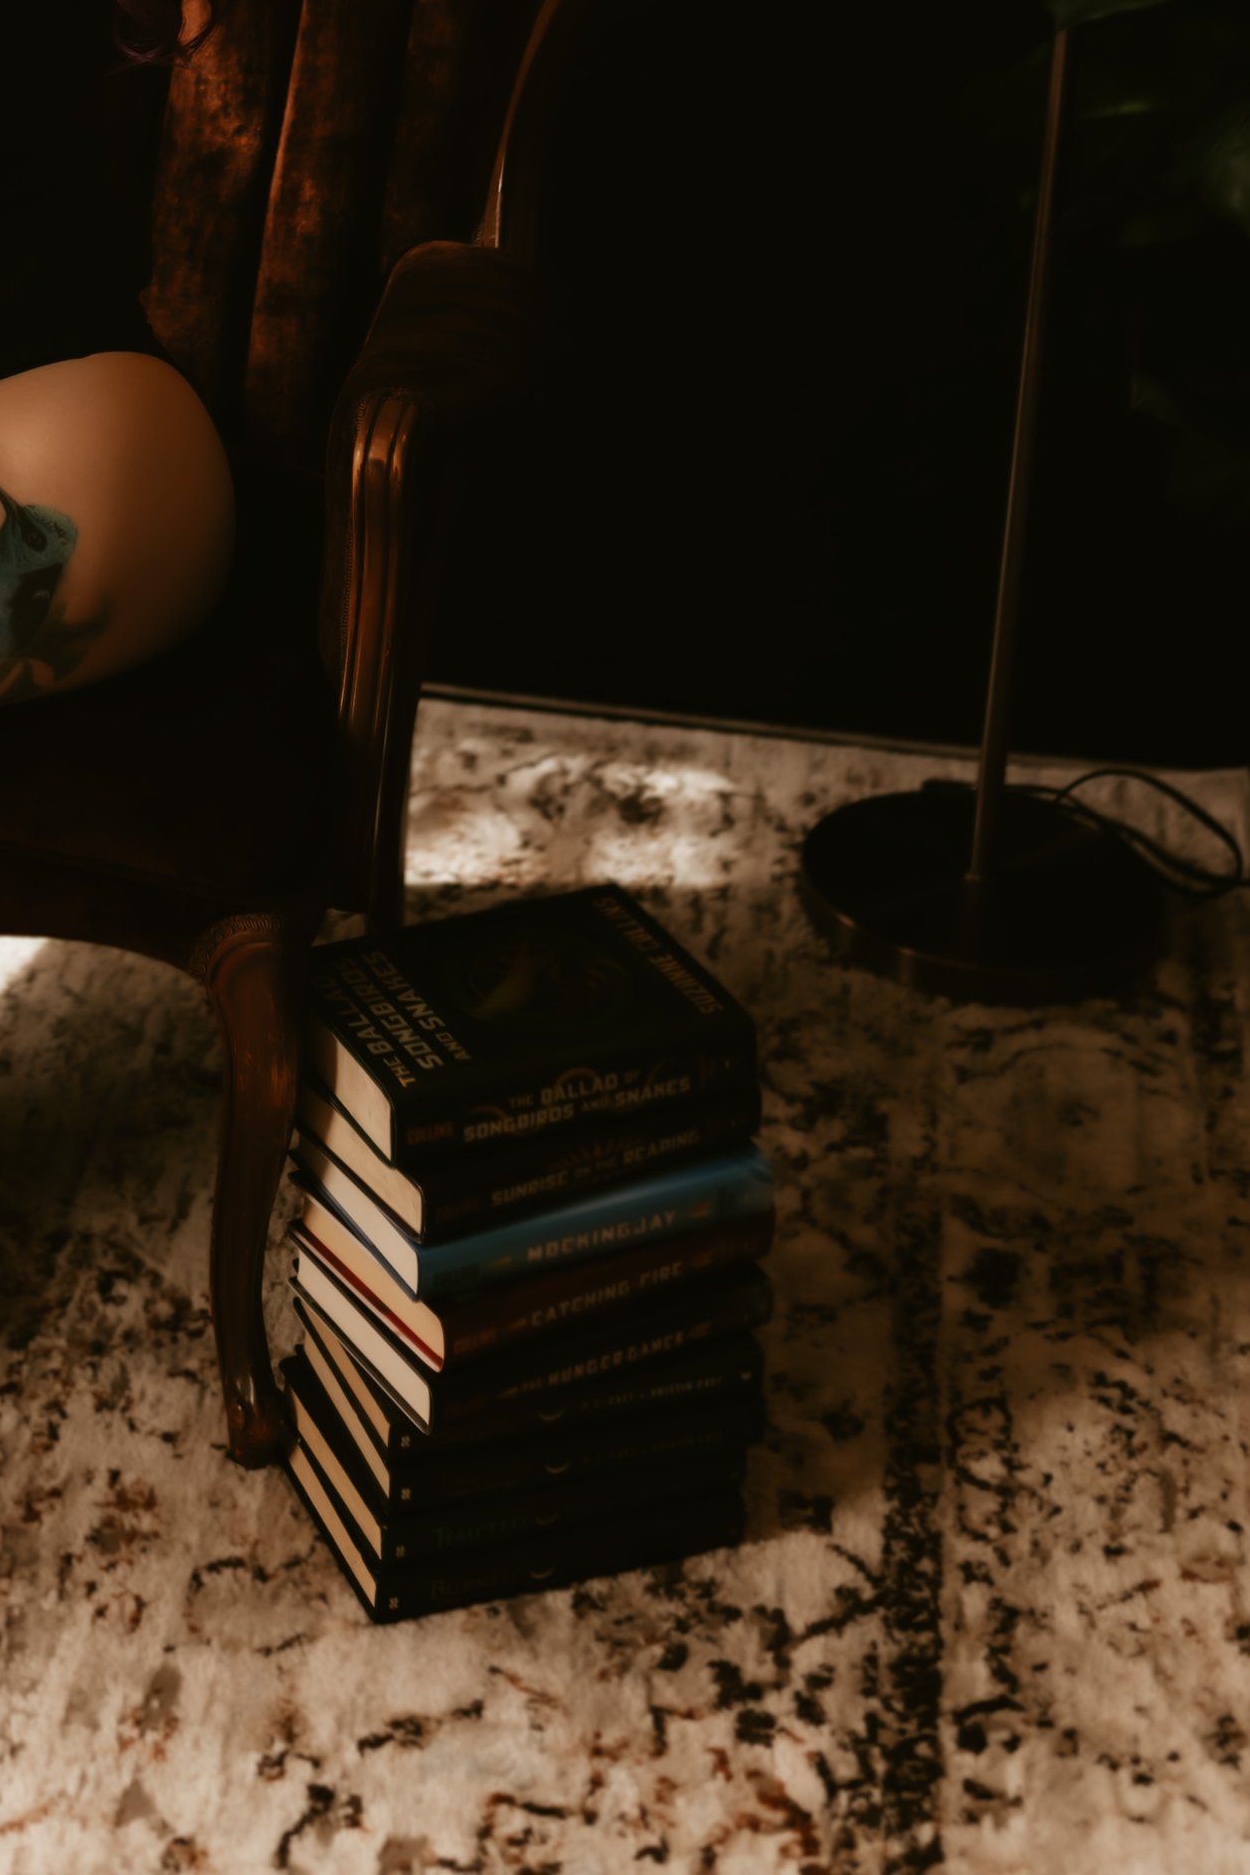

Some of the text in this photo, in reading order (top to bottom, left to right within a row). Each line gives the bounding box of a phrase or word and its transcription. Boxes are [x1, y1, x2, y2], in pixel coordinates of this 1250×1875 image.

[310, 975, 417, 1088] THE BALLAD
[335, 956, 445, 1070] SONGBIRDS
[362, 950, 473, 1061] AND SNAKES
[462, 1102, 576, 1144] SONGBIRDS
[613, 1075, 692, 1108] SNAKES
[508, 1093, 535, 1110] THE
[539, 1071, 620, 1106] BALLAD
[490, 1169, 571, 1208] SUNRISE
[525, 1209, 678, 1263] MOCKINGJAY
[529, 1259, 685, 1328] CATCHING FIRE
[547, 1349, 625, 1389] HUNGER
[625, 1330, 686, 1363] GAMES
